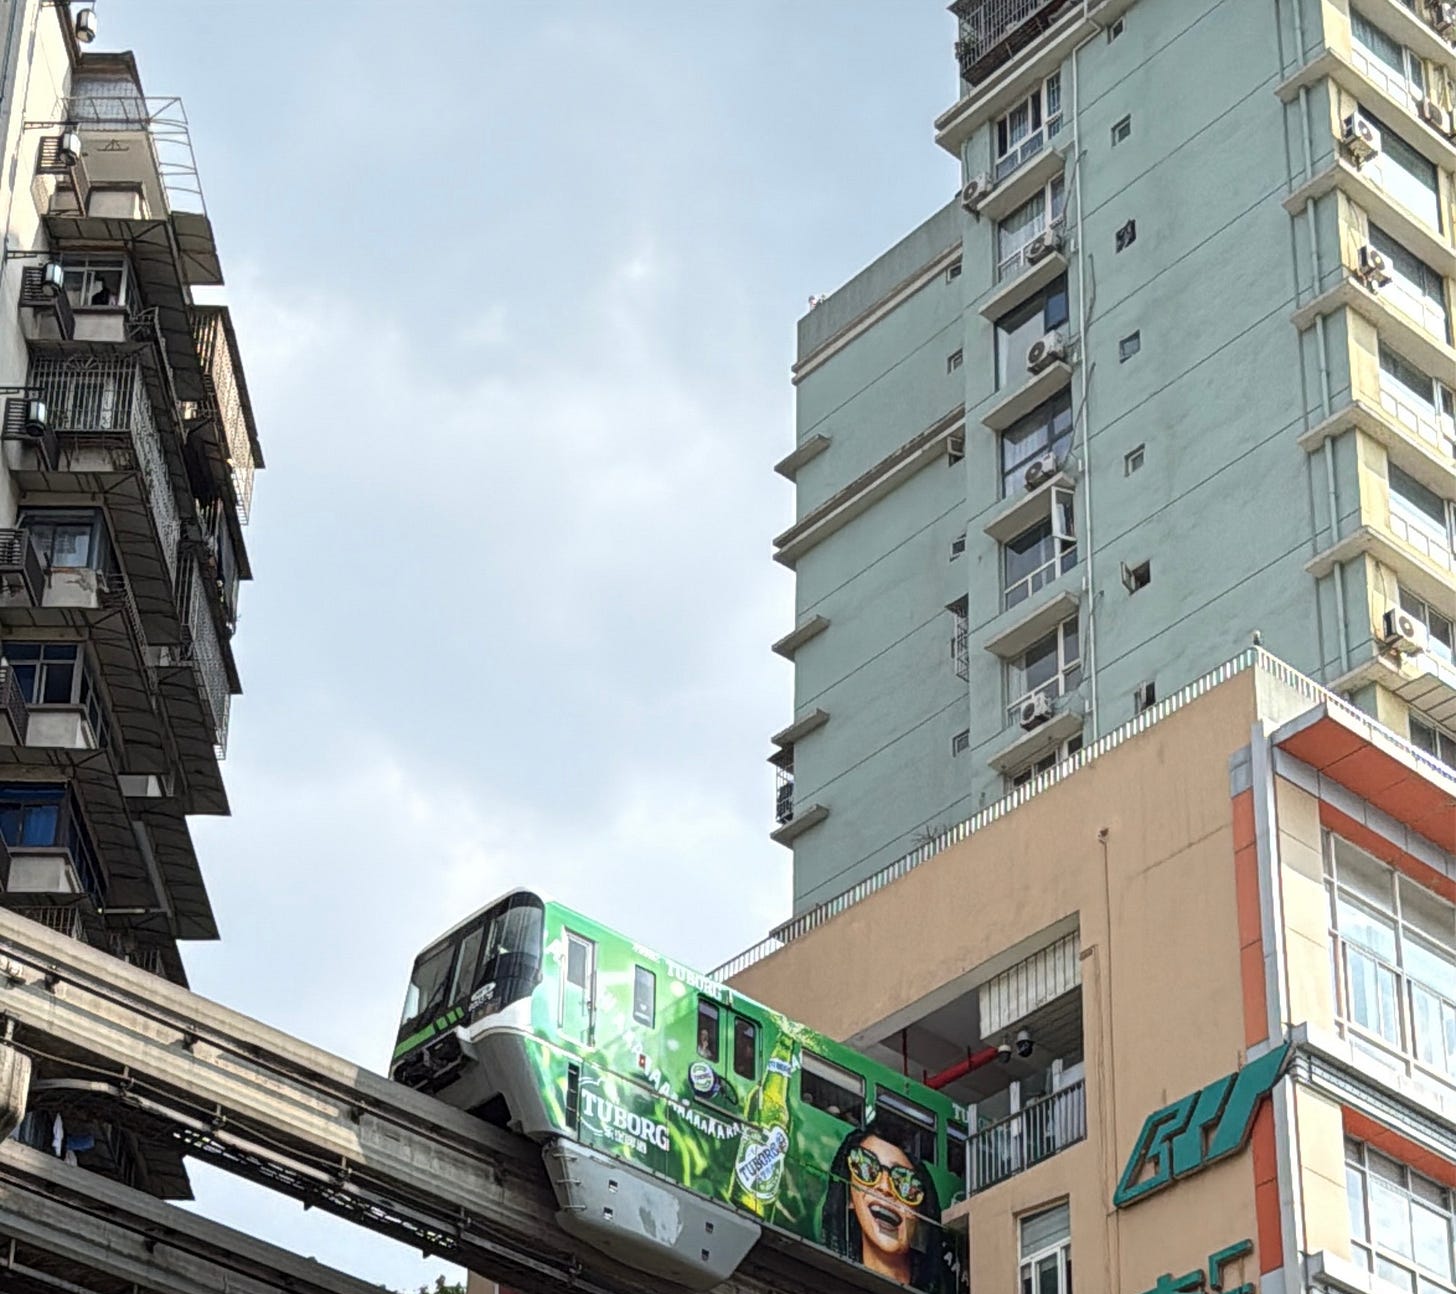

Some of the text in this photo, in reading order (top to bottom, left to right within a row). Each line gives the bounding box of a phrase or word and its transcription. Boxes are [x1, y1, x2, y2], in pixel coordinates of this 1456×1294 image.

[664, 959, 722, 1001] TUBORG
[581, 1088, 670, 1152] TUBORG
[739, 1142, 780, 1182] TUBORG
